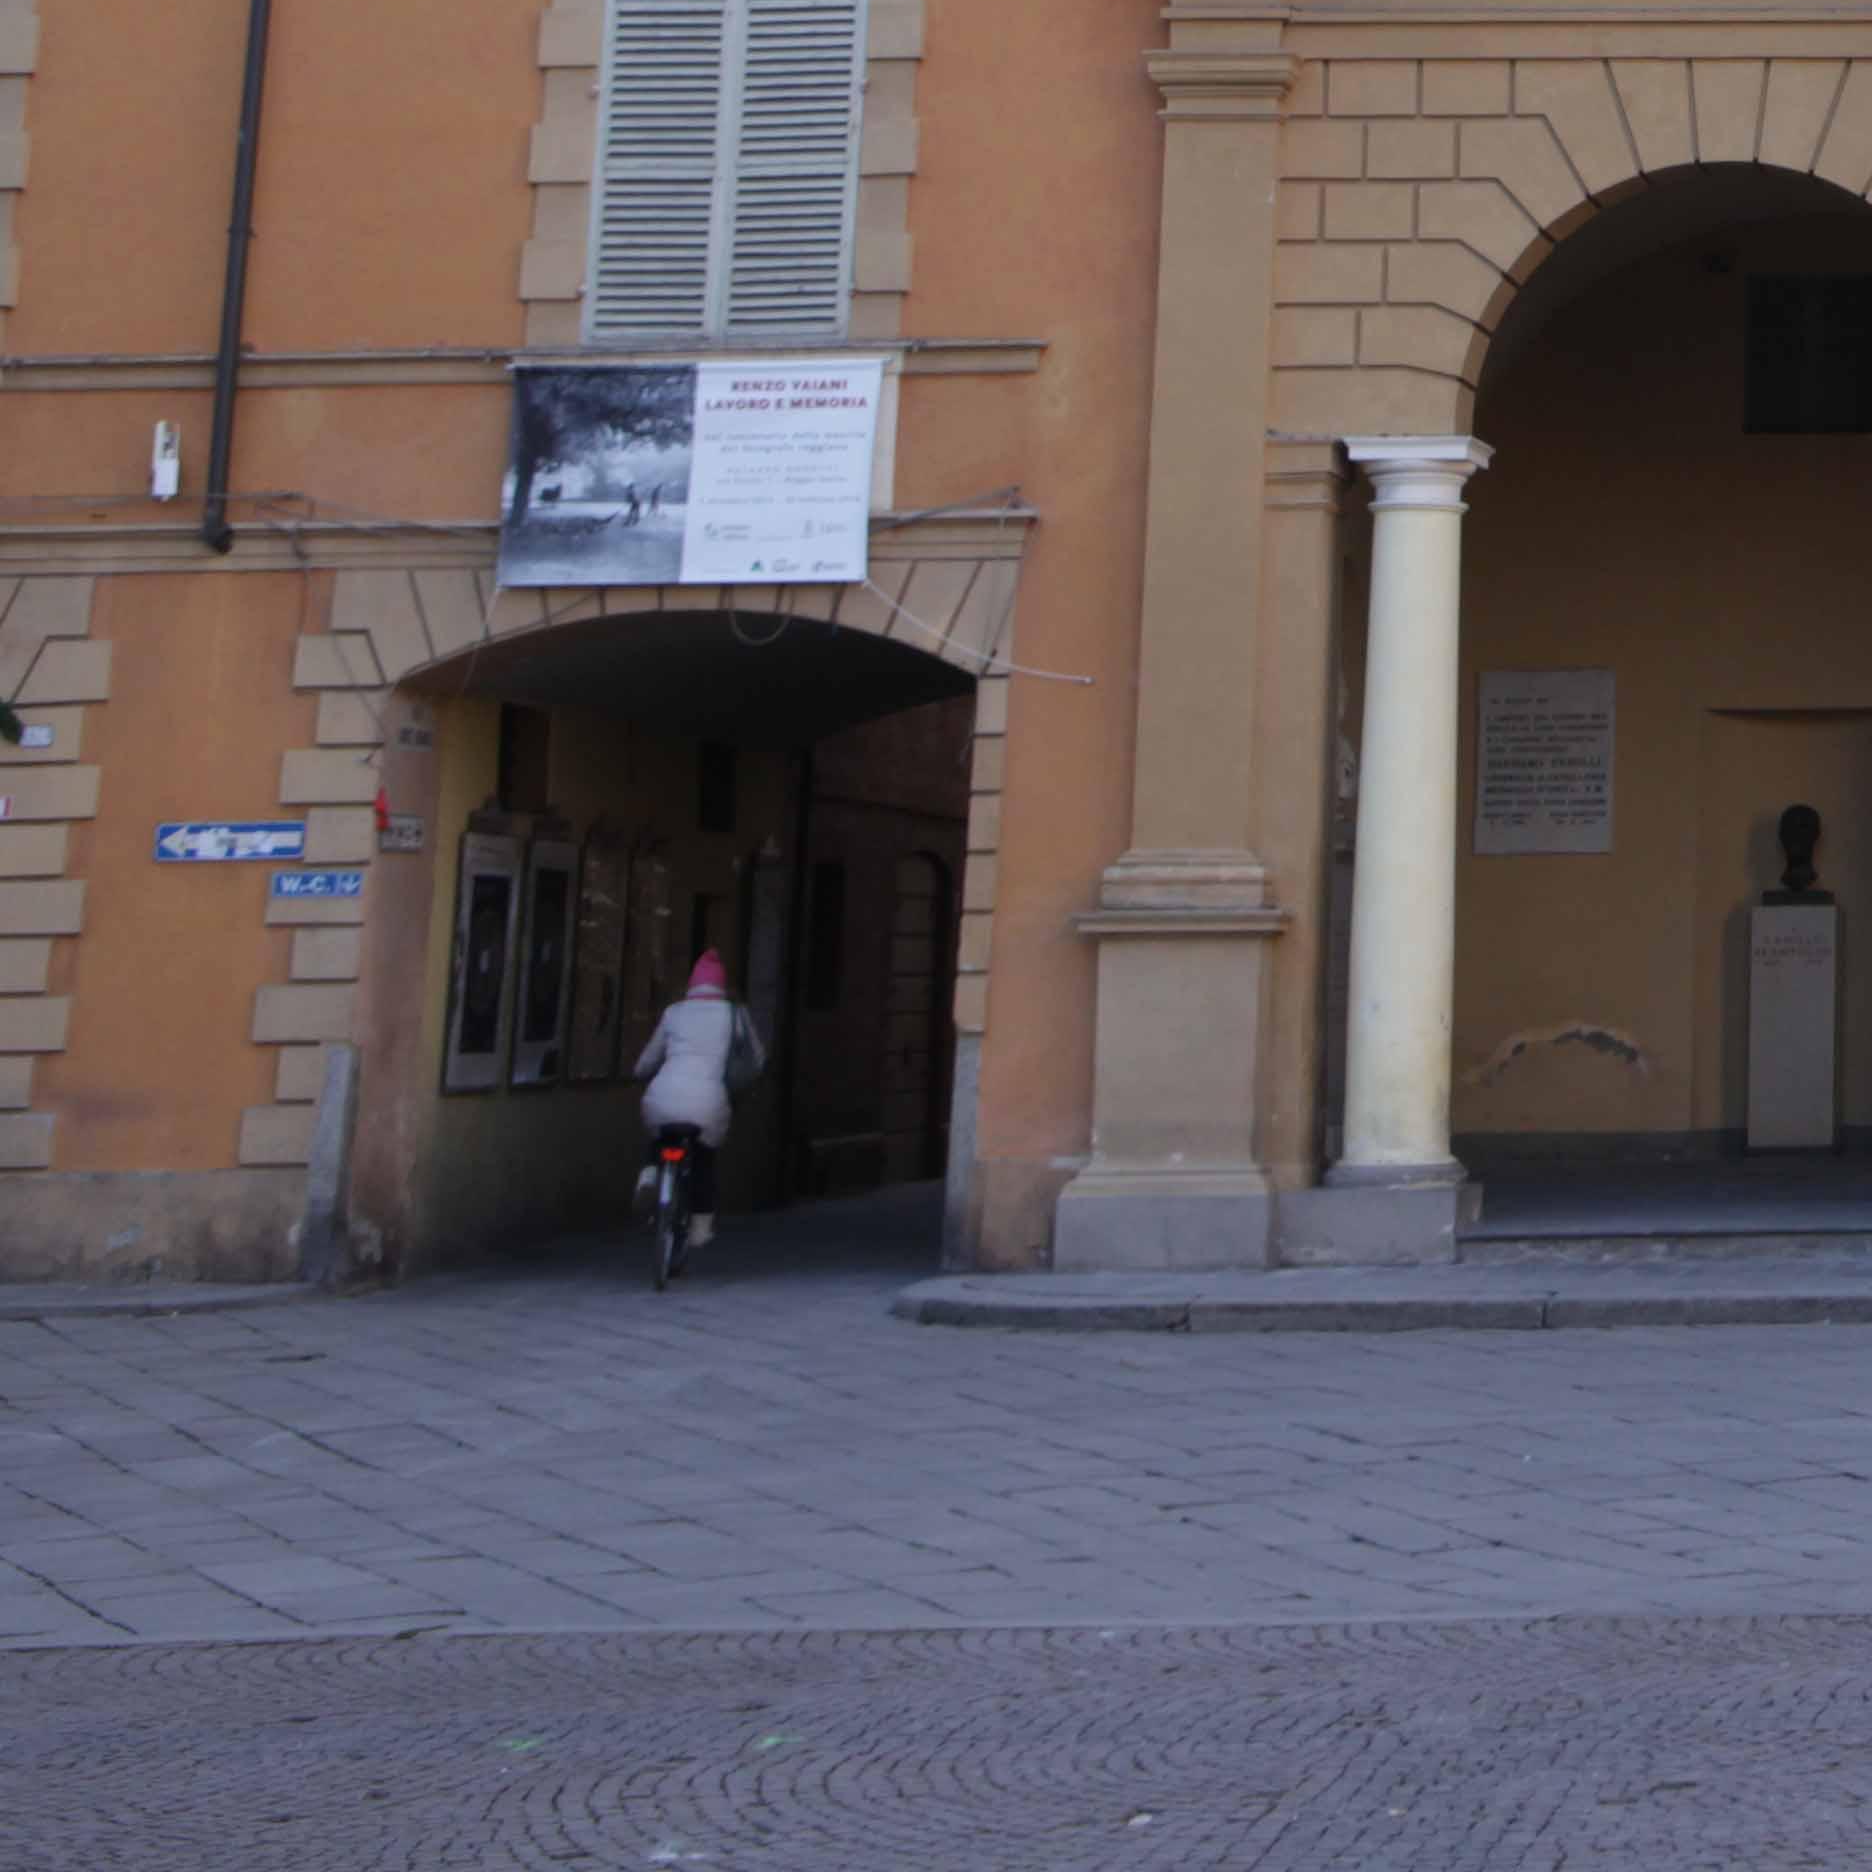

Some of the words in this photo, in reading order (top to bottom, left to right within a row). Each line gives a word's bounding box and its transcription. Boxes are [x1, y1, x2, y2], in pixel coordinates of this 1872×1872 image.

[731, 380, 786, 392] RENZO
[791, 379, 849, 391] VAIANI
[705, 398, 770, 411] LAVORO
[775, 398, 784, 410] E
[790, 397, 868, 409] MEMORIA
